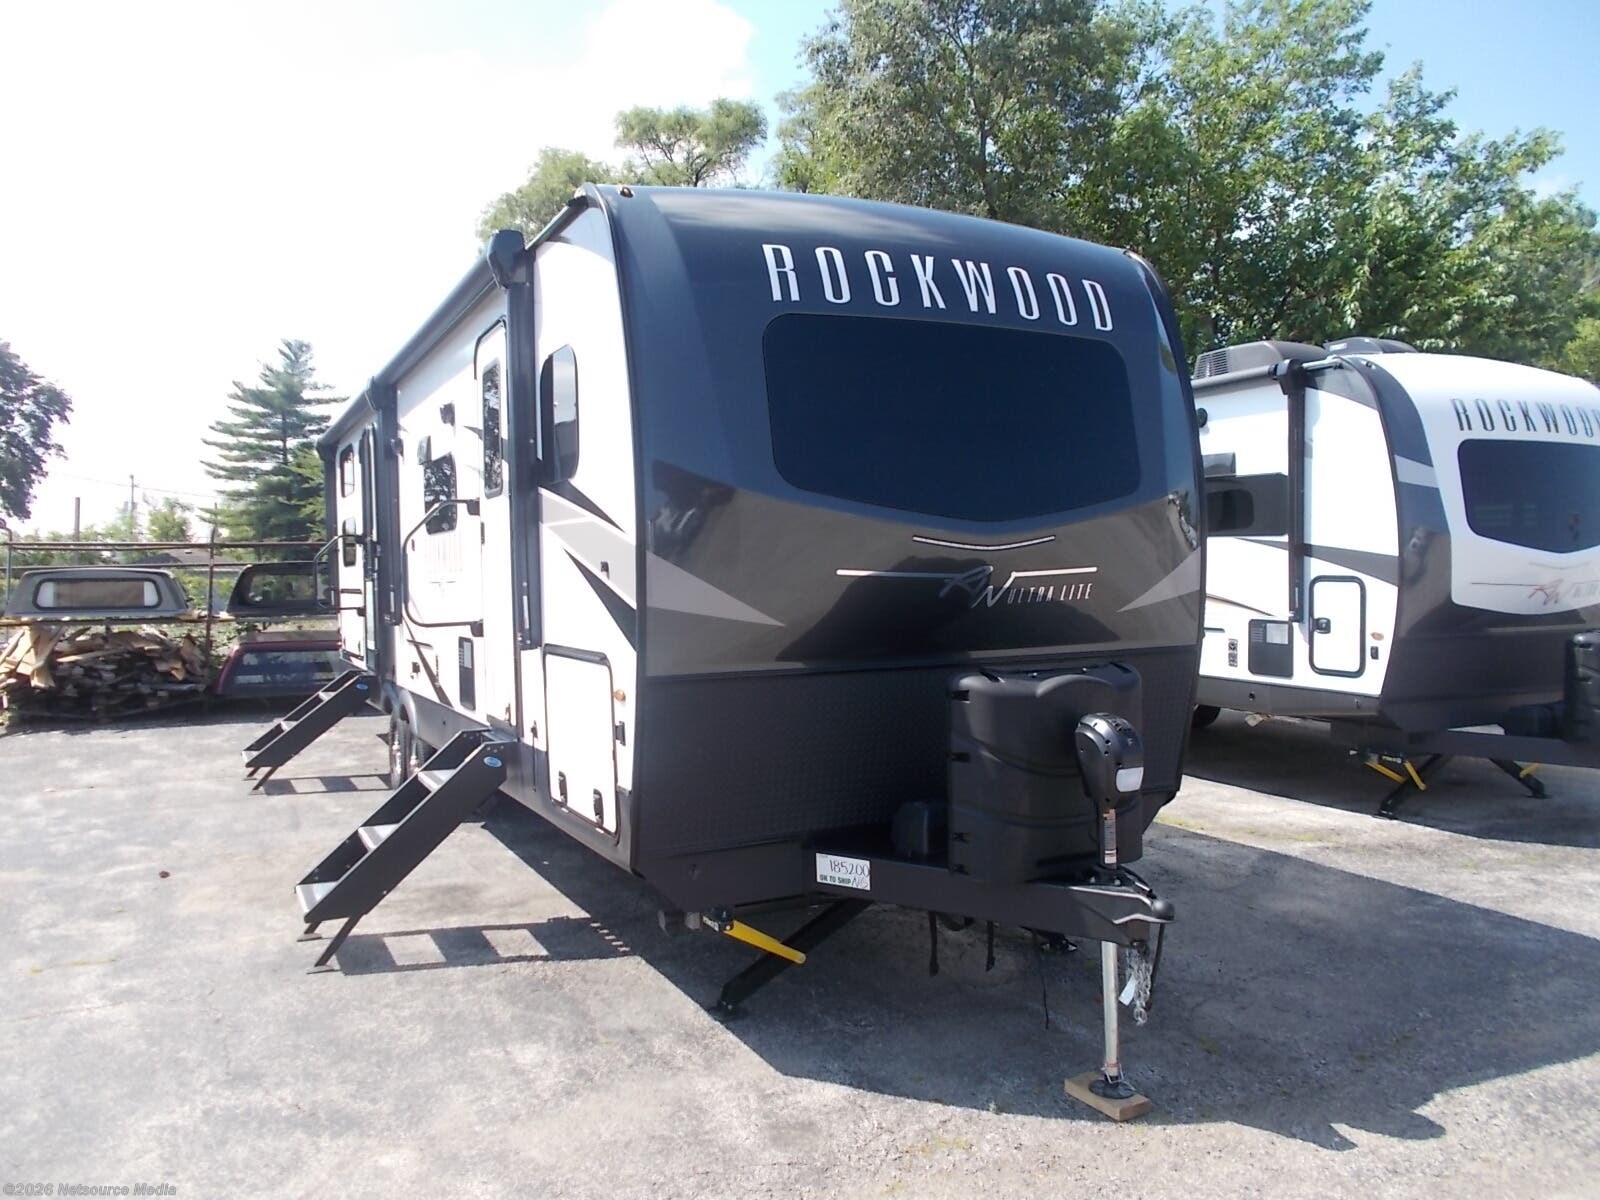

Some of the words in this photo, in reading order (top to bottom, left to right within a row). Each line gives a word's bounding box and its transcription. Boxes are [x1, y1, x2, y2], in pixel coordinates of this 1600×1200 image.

[762, 244, 1114, 332] ROCKWOOD
[1007, 586, 1055, 604] ULTRA
[1060, 583, 1092, 601] LITE
